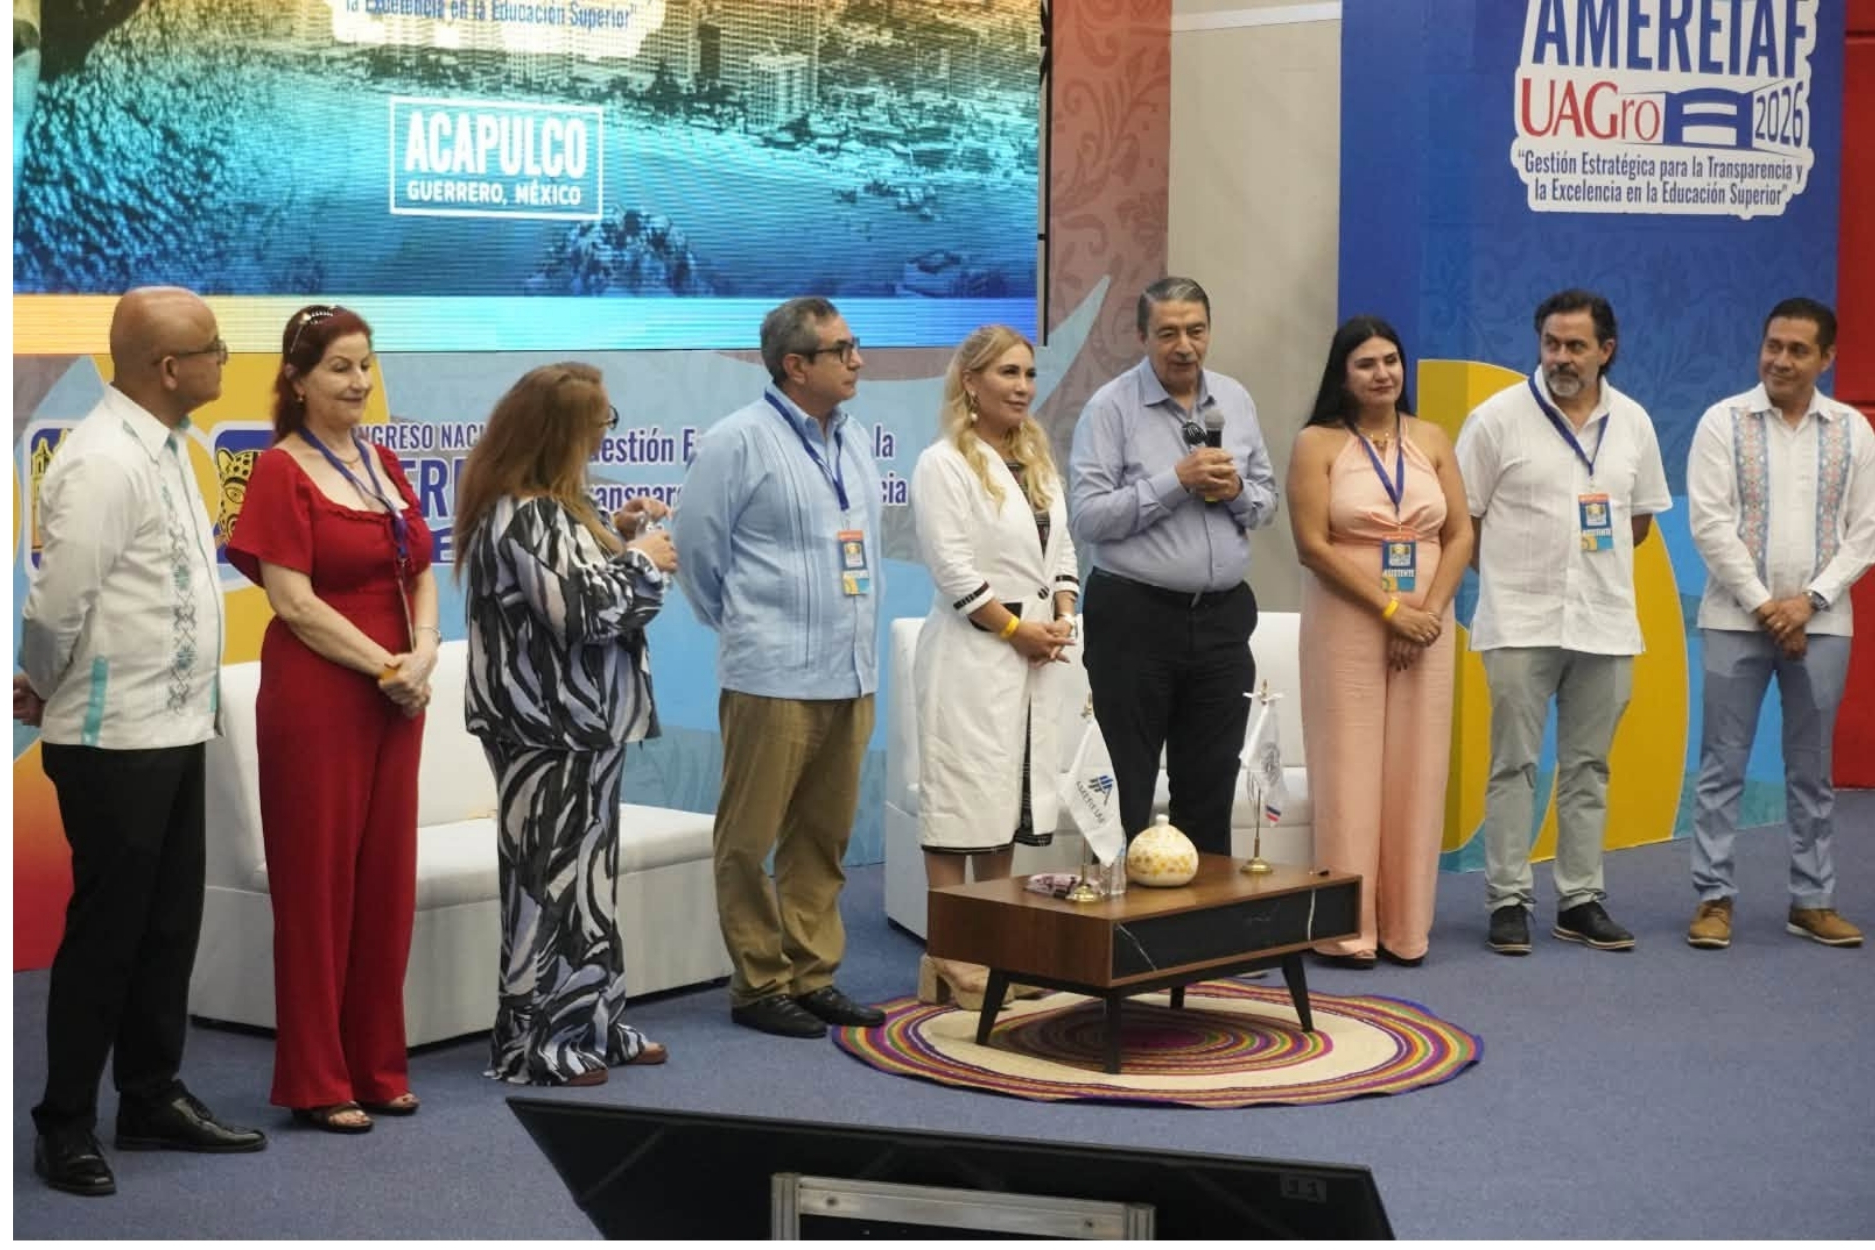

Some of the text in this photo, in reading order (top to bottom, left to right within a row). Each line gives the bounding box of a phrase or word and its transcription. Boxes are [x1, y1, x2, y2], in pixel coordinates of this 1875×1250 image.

[492, 0, 564, 24] Educación
[1532, 0, 1807, 79] AMEREIAF
[1521, 77, 1804, 148] UAGro 2026
[404, 111, 587, 179] ACAPULCO
[1582, 152, 1656, 181] Estratégica
[1660, 159, 1688, 182] para
[1692, 156, 1703, 178] la
[1708, 156, 1793, 184] Transparencia
[1796, 165, 1803, 183] y
[407, 178, 581, 206] GUERRERO, MÉXICO
[1535, 178, 1547, 200] la
[1552, 180, 1622, 202] Excelencia
[1626, 187, 1643, 203] en
[1646, 182, 1657, 203] la
[1662, 181, 1725, 206] Educación
[358, 424, 434, 449] NGRESO
[589, 428, 674, 463] estión
[876, 425, 894, 458] la
